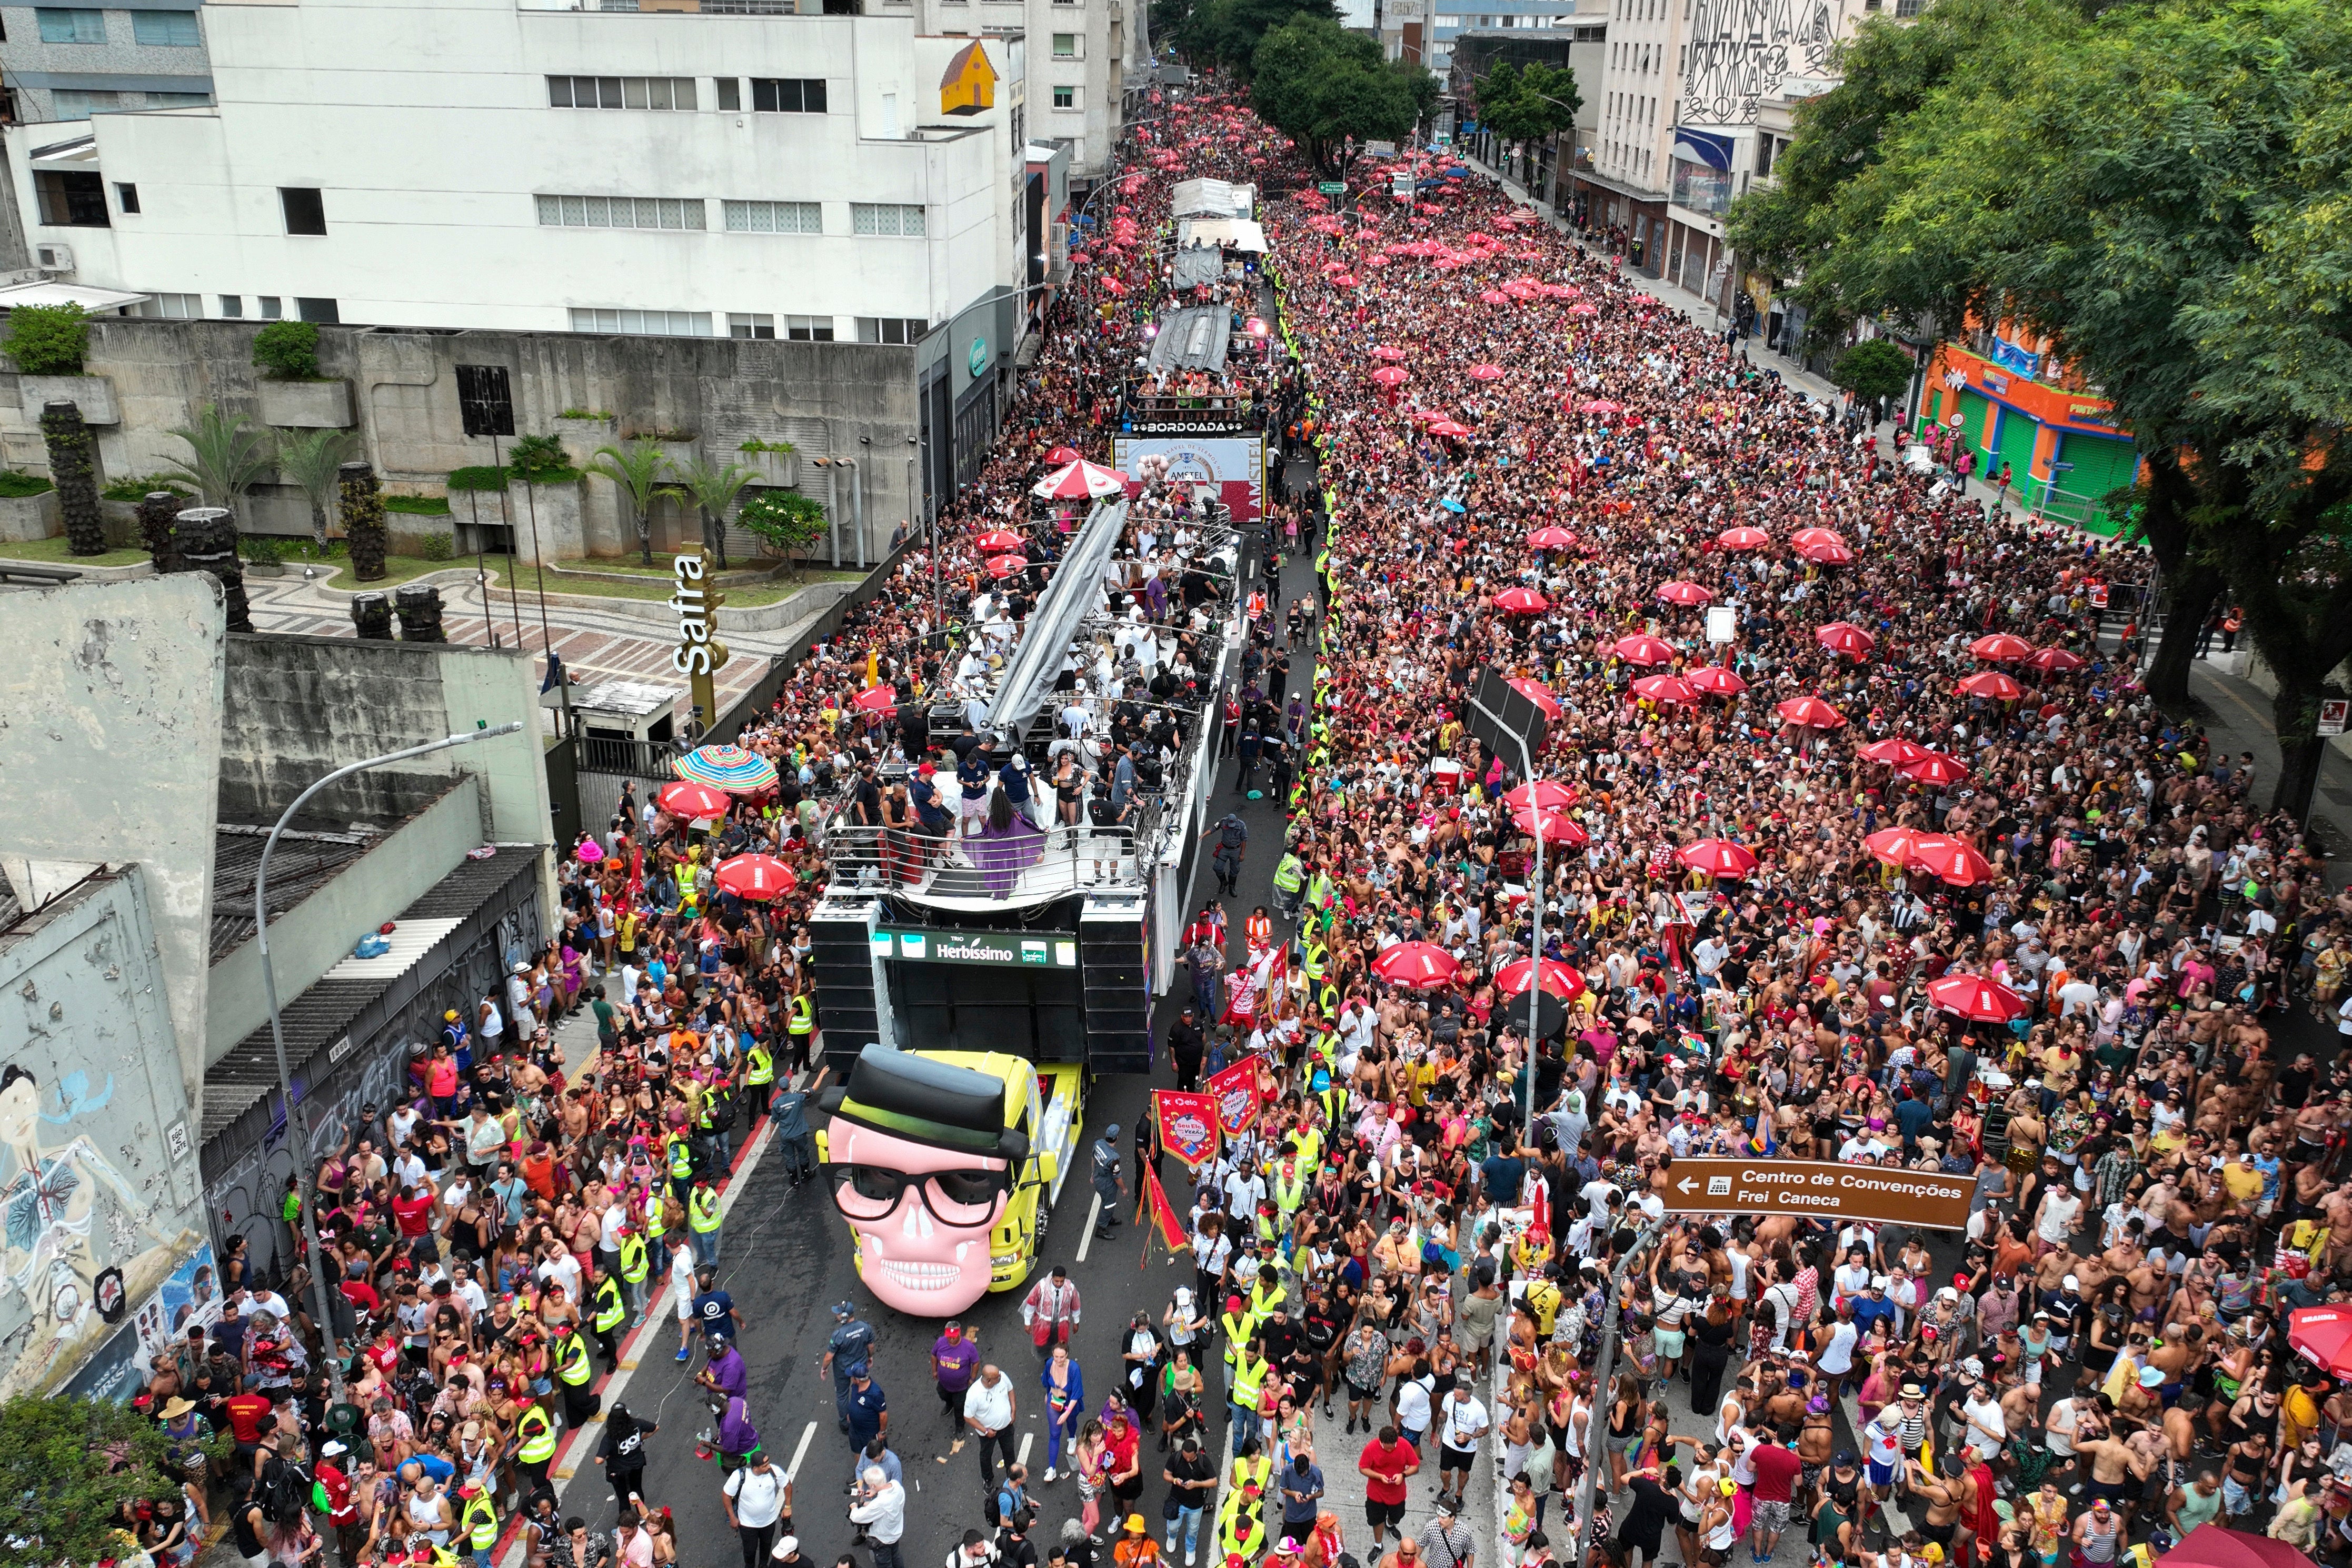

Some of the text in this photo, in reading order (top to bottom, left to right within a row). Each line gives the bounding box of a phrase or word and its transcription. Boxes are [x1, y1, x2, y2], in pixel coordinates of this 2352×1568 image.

[1148, 422, 1226, 432] BORDOADA
[667, 555, 711, 676] Safra
[174, 1141, 187, 1156] ARTE
[1741, 1170, 1962, 1199] Centro de Convenções
[1738, 1190, 1840, 1206] Frei Caneca
[2301, 1314, 2338, 1323] BRAHMA
